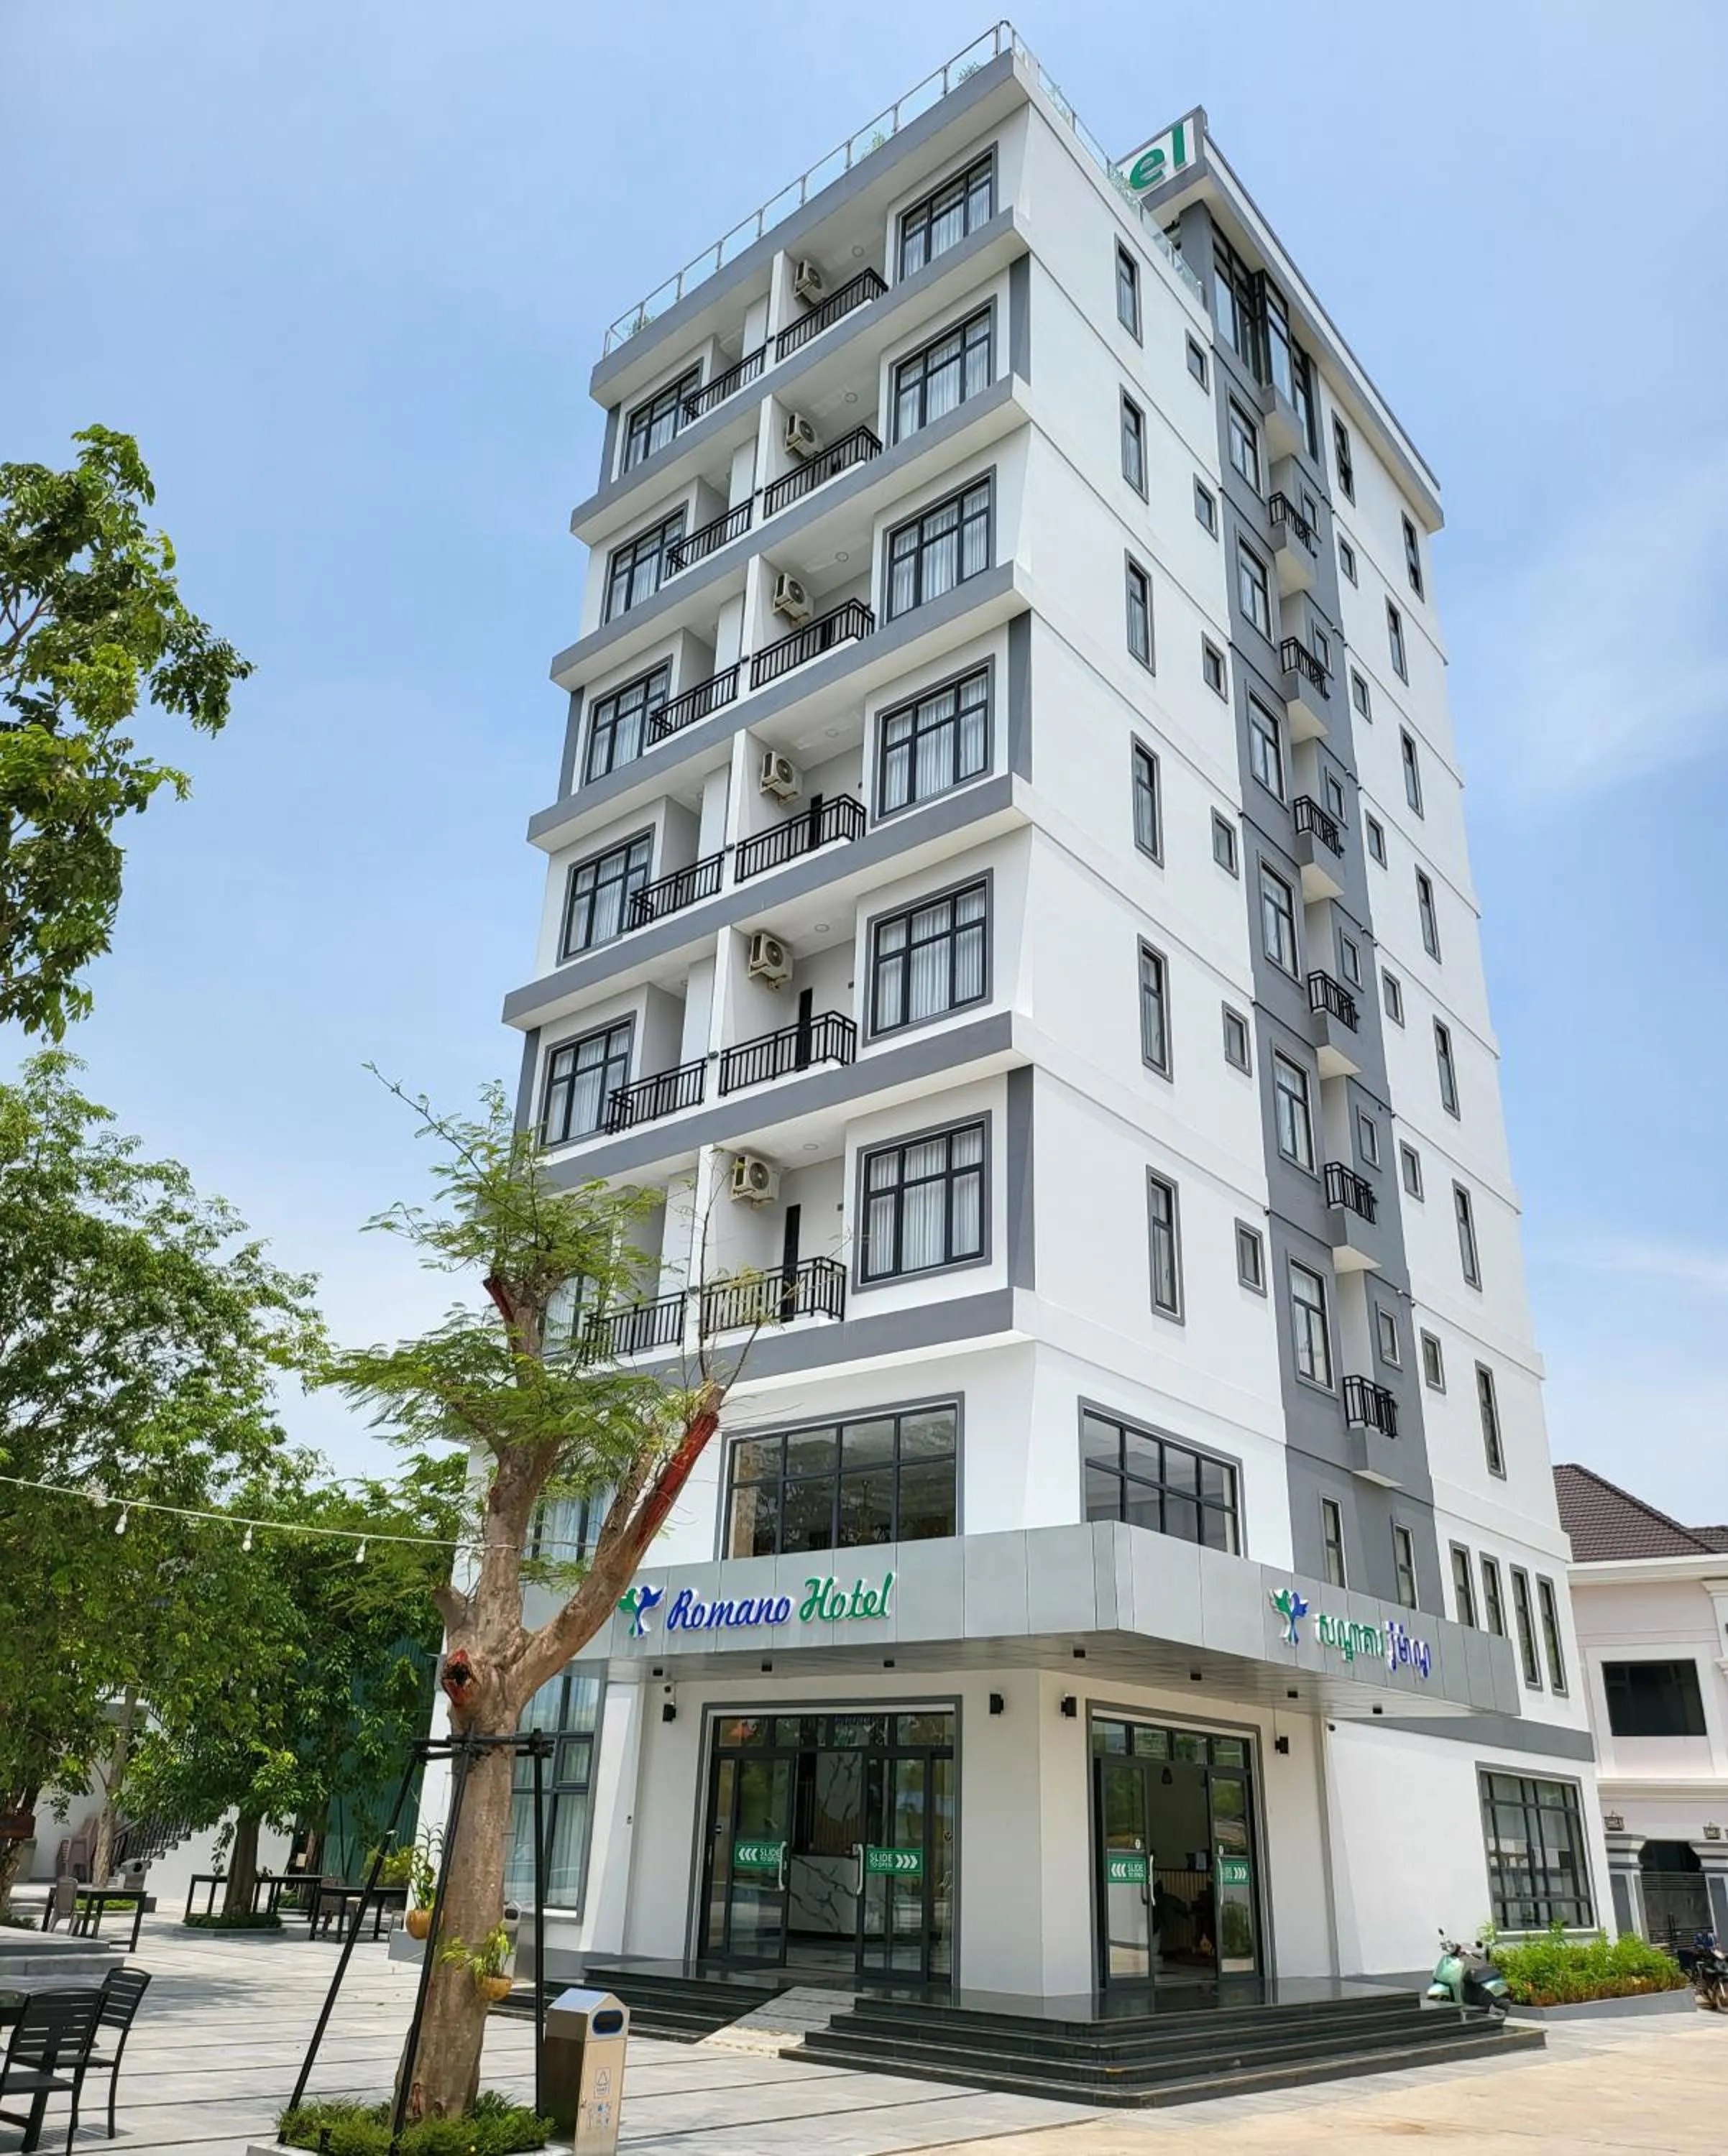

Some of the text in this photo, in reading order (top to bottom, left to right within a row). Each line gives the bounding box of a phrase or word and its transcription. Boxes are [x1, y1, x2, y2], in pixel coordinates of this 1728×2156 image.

[666, 1571, 895, 1631] Romano Hotel
[869, 1853, 893, 1862] SLIDE
